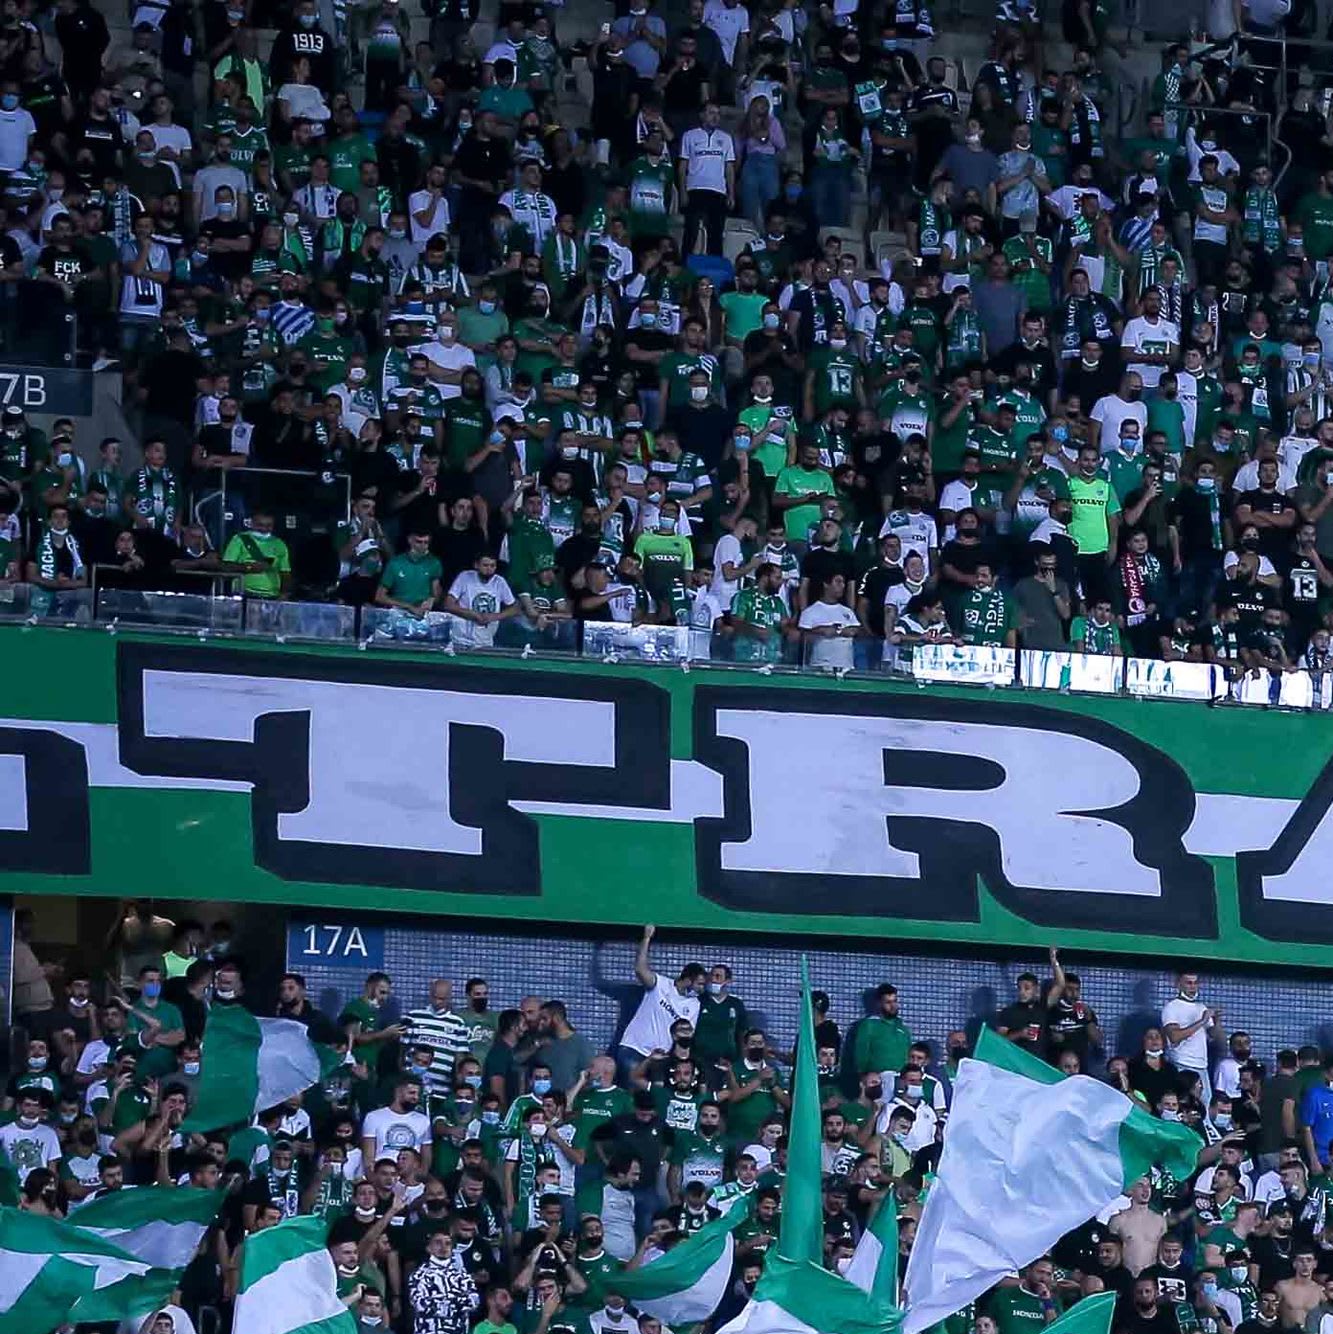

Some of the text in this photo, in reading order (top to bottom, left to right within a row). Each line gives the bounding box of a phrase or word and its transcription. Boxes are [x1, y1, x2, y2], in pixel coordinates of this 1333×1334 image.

[293, 33, 324, 51] 1913
[54, 260, 82, 274] FCK
[830, 369, 852, 392] 13
[1073, 499, 1105, 507] VOLVO
[647, 555, 683, 563] VOLVO
[1293, 573, 1319, 599] 13
[302, 923, 369, 958] 17A
[418, 1034, 452, 1047] HONDA
[582, 1107, 613, 1118] HONDA
[689, 1169, 723, 1178] VOLVO
[1011, 1309, 1045, 1320] HONDA
